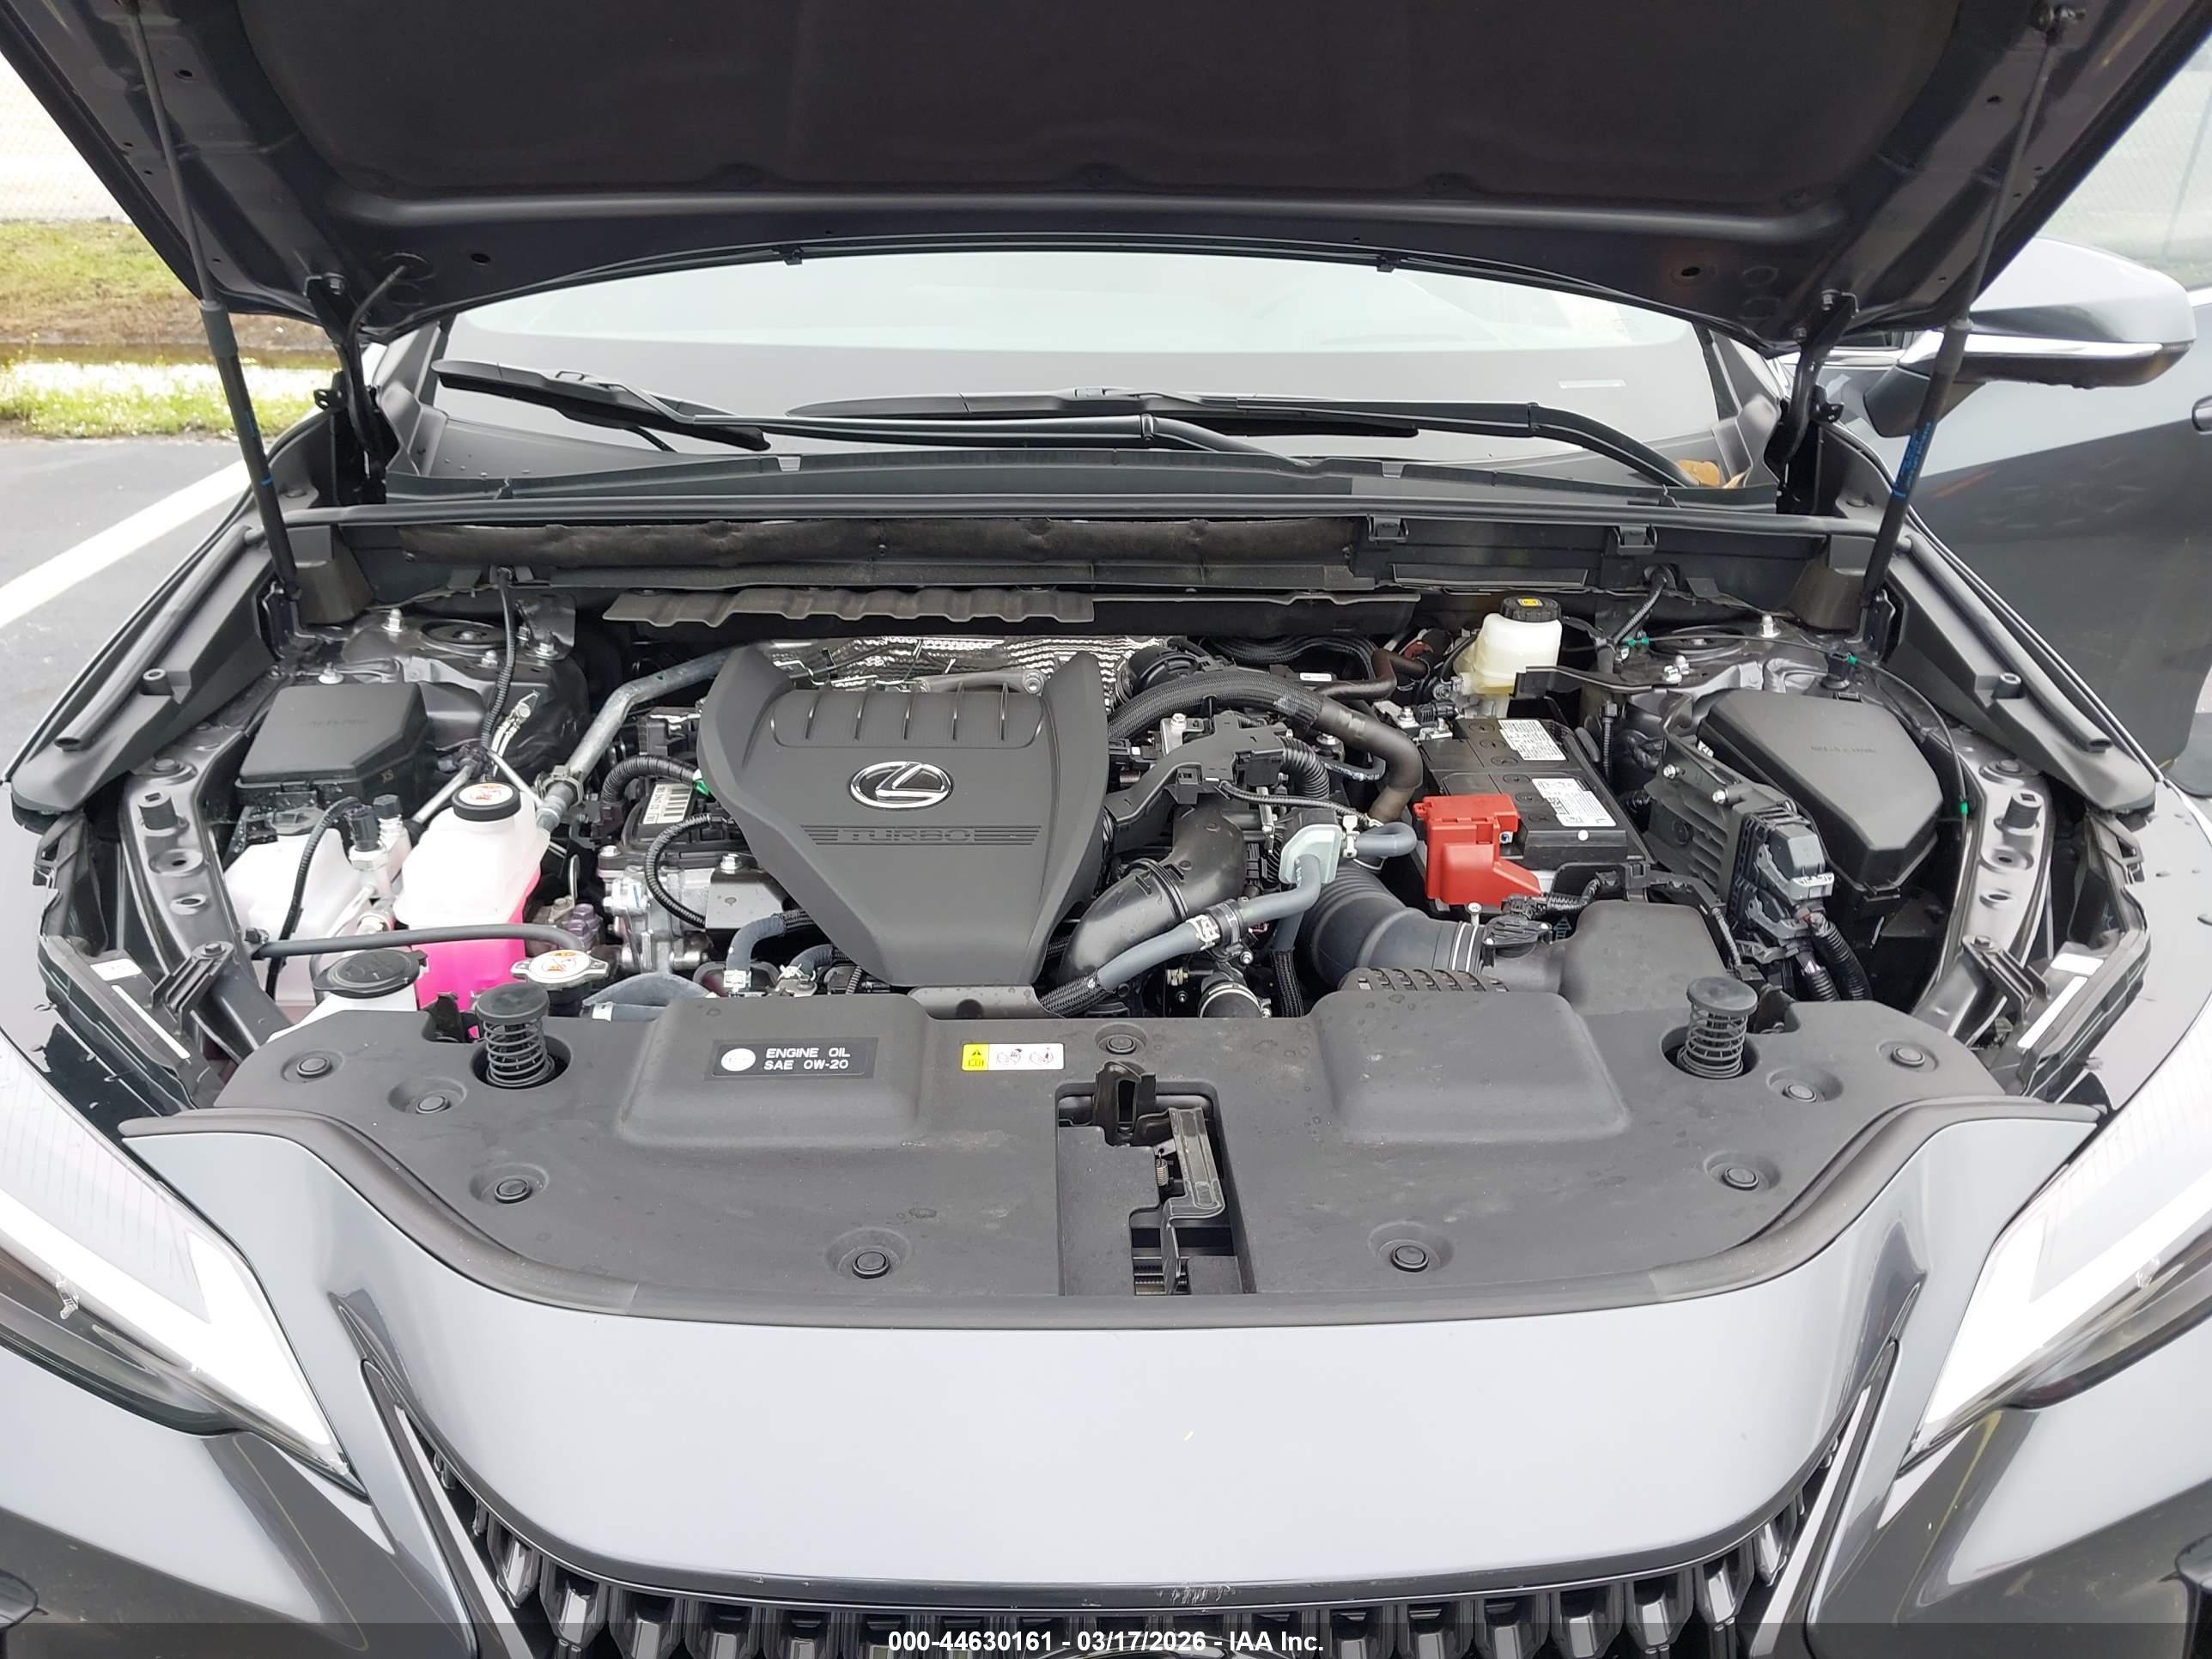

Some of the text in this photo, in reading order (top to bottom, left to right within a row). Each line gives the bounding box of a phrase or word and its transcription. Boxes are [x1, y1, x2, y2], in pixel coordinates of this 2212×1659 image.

[842, 829, 970, 842] TURBO
[766, 1048, 850, 1059] ENGINE OIL
[763, 1060, 794, 1071] SAE
[803, 1059, 849, 1070] 0W-20
